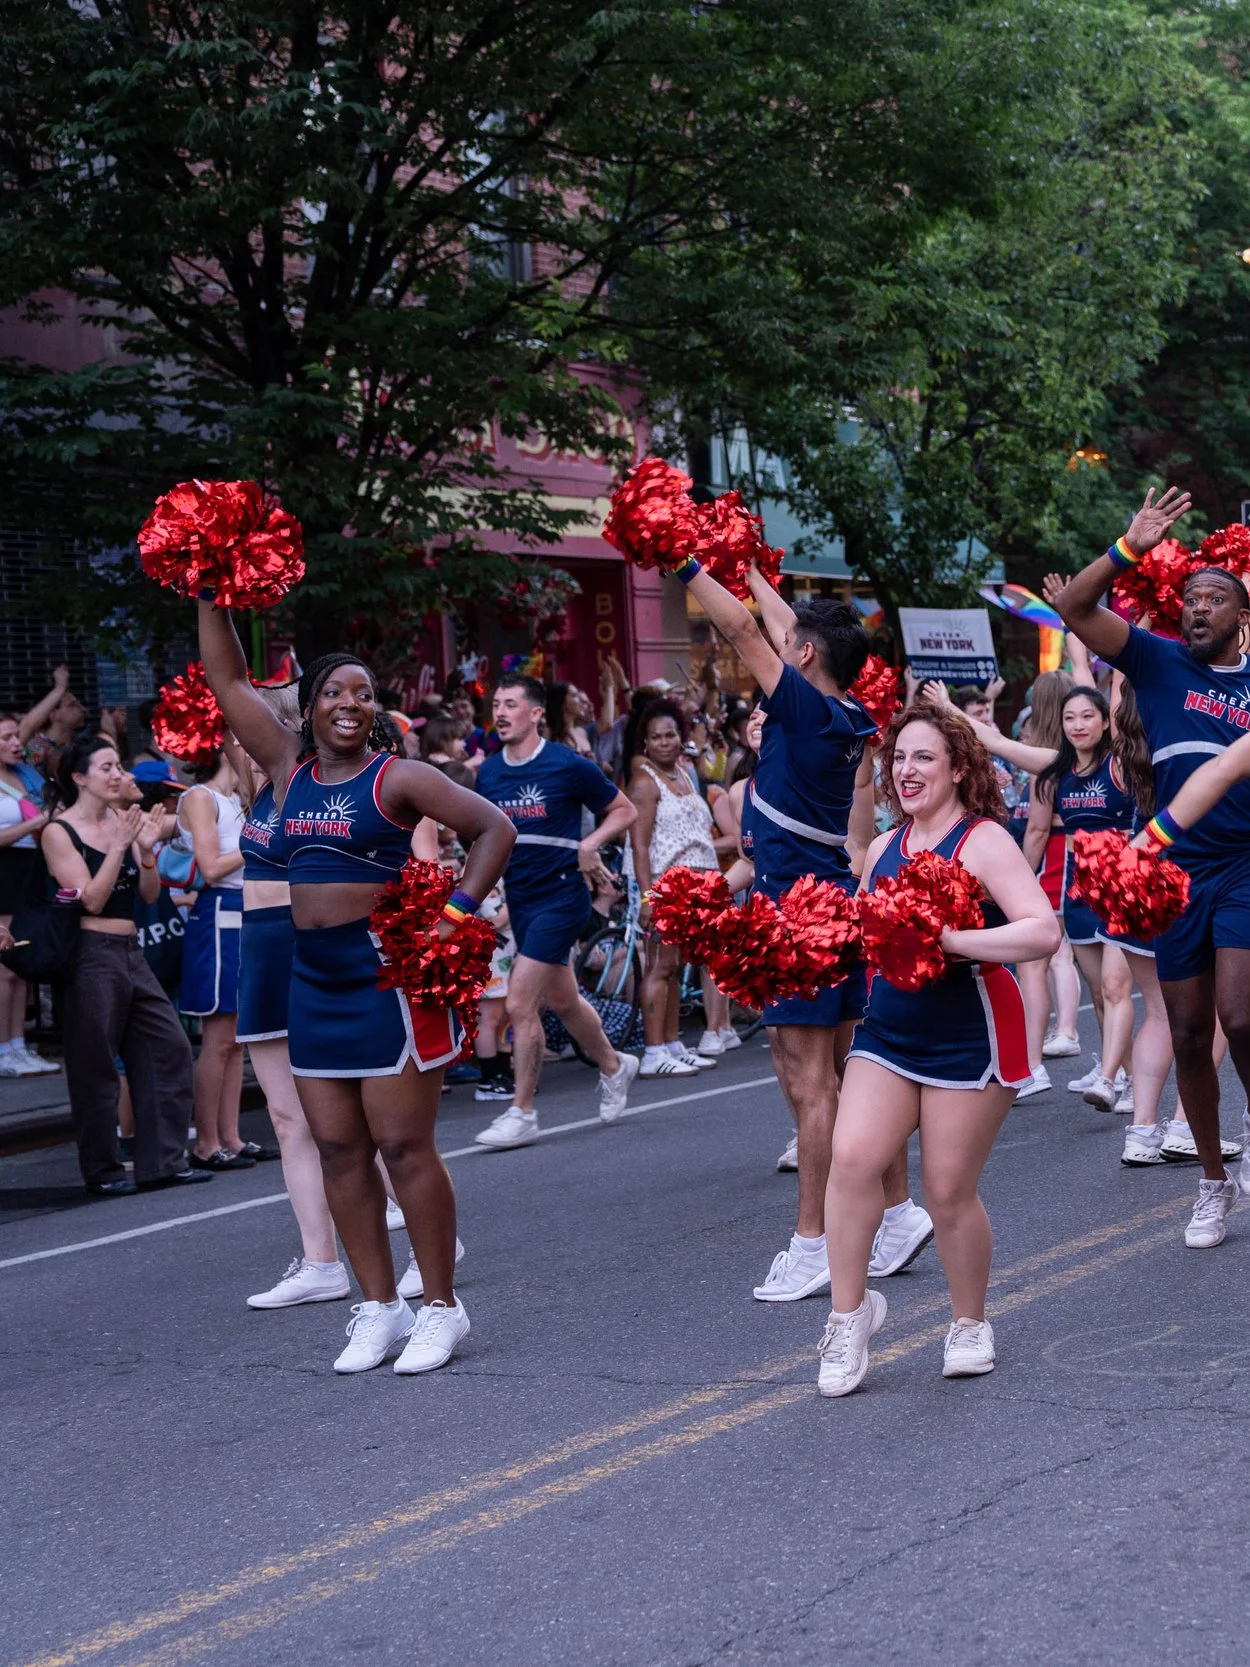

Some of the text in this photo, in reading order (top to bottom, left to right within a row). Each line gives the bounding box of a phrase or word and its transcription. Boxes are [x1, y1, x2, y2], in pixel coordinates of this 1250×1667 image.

[920, 638, 975, 652] NEW YORK
[1184, 689, 1227, 719] NEW
[498, 799, 532, 807] CHEER
[1062, 796, 1107, 809] NEW YORK
[299, 811, 338, 820] CHEER
[514, 803, 548, 819] YORK
[285, 819, 352, 839] NEW YORK
